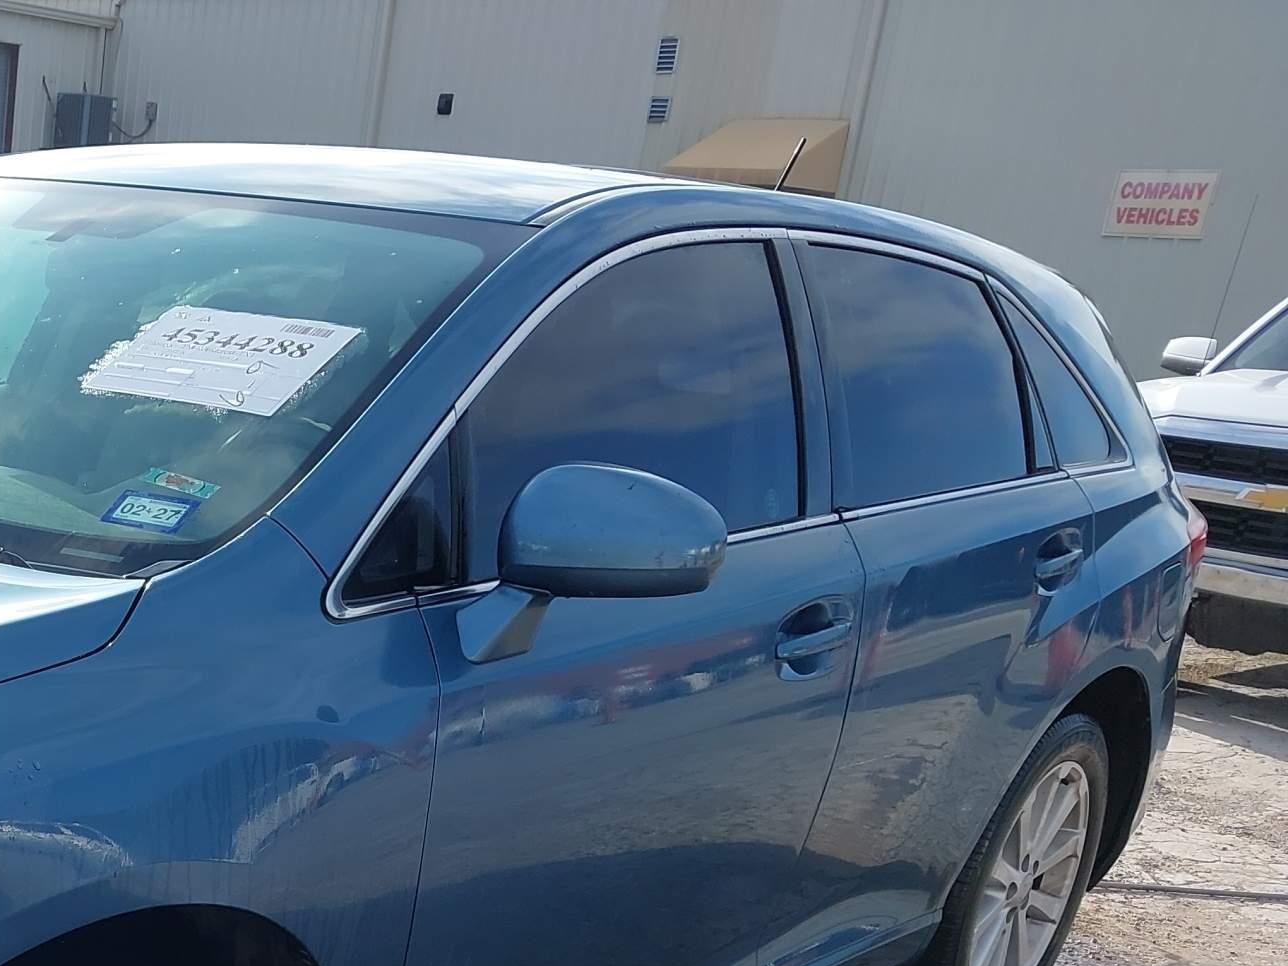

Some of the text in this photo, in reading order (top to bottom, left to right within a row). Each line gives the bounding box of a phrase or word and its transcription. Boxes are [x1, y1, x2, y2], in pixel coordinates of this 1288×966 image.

[1120, 181, 1208, 200] COMPANY
[1115, 207, 1200, 226] VEHICLES
[162, 327, 315, 359] 45344288
